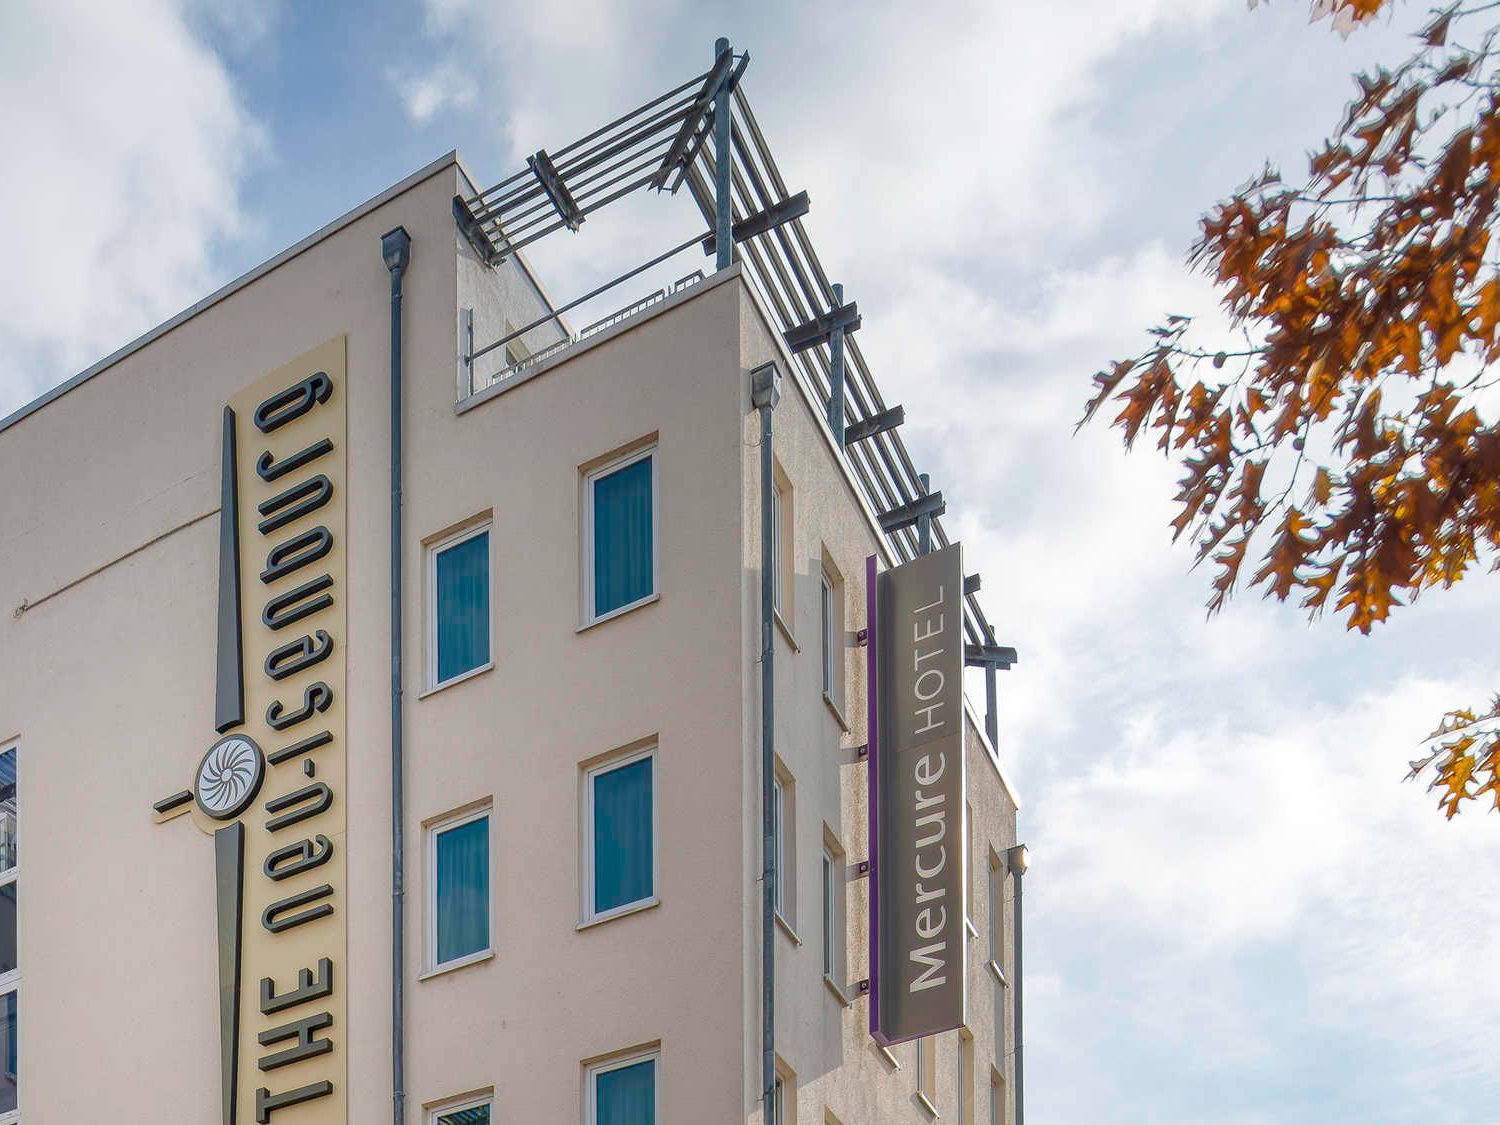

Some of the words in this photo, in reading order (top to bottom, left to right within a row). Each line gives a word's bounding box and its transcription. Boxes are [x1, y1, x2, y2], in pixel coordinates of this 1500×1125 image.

[913, 583, 946, 736] HOTEL
[908, 750, 947, 994] Mercure
[255, 956, 334, 1125] THE
